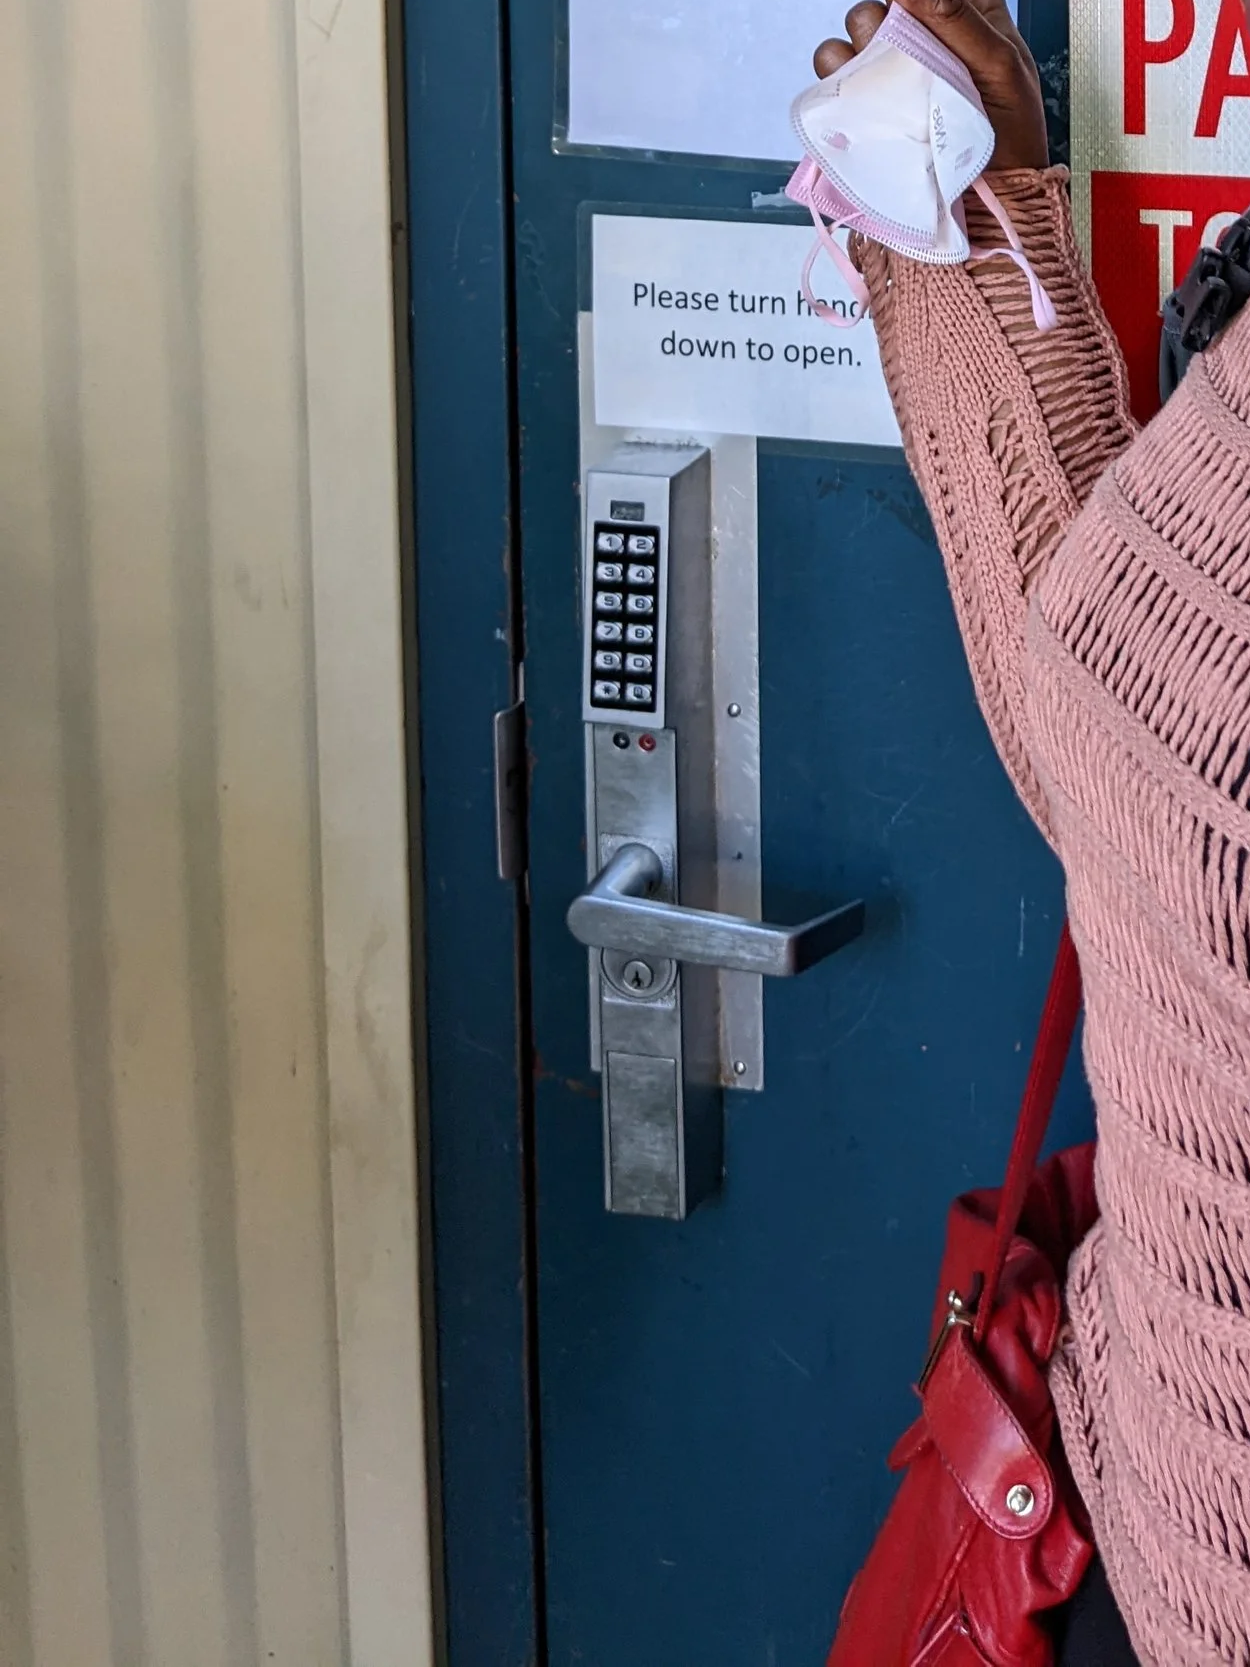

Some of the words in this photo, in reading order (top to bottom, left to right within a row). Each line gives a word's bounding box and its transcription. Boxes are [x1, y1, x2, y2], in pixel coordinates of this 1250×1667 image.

[633, 282, 720, 312] Please
[728, 290, 786, 316] turn
[660, 330, 736, 360] down
[746, 337, 774, 362] to
[783, 344, 862, 370] open.
[605, 536, 614, 548] 1
[636, 539, 647, 550] 2
[604, 566, 615, 577] 3
[636, 569, 646, 580] 4
[603, 595, 614, 607] 5
[635, 598, 645, 609] 6
[603, 625, 614, 636] 7
[634, 628, 645, 640] 8
[603, 654, 614, 666] 9
